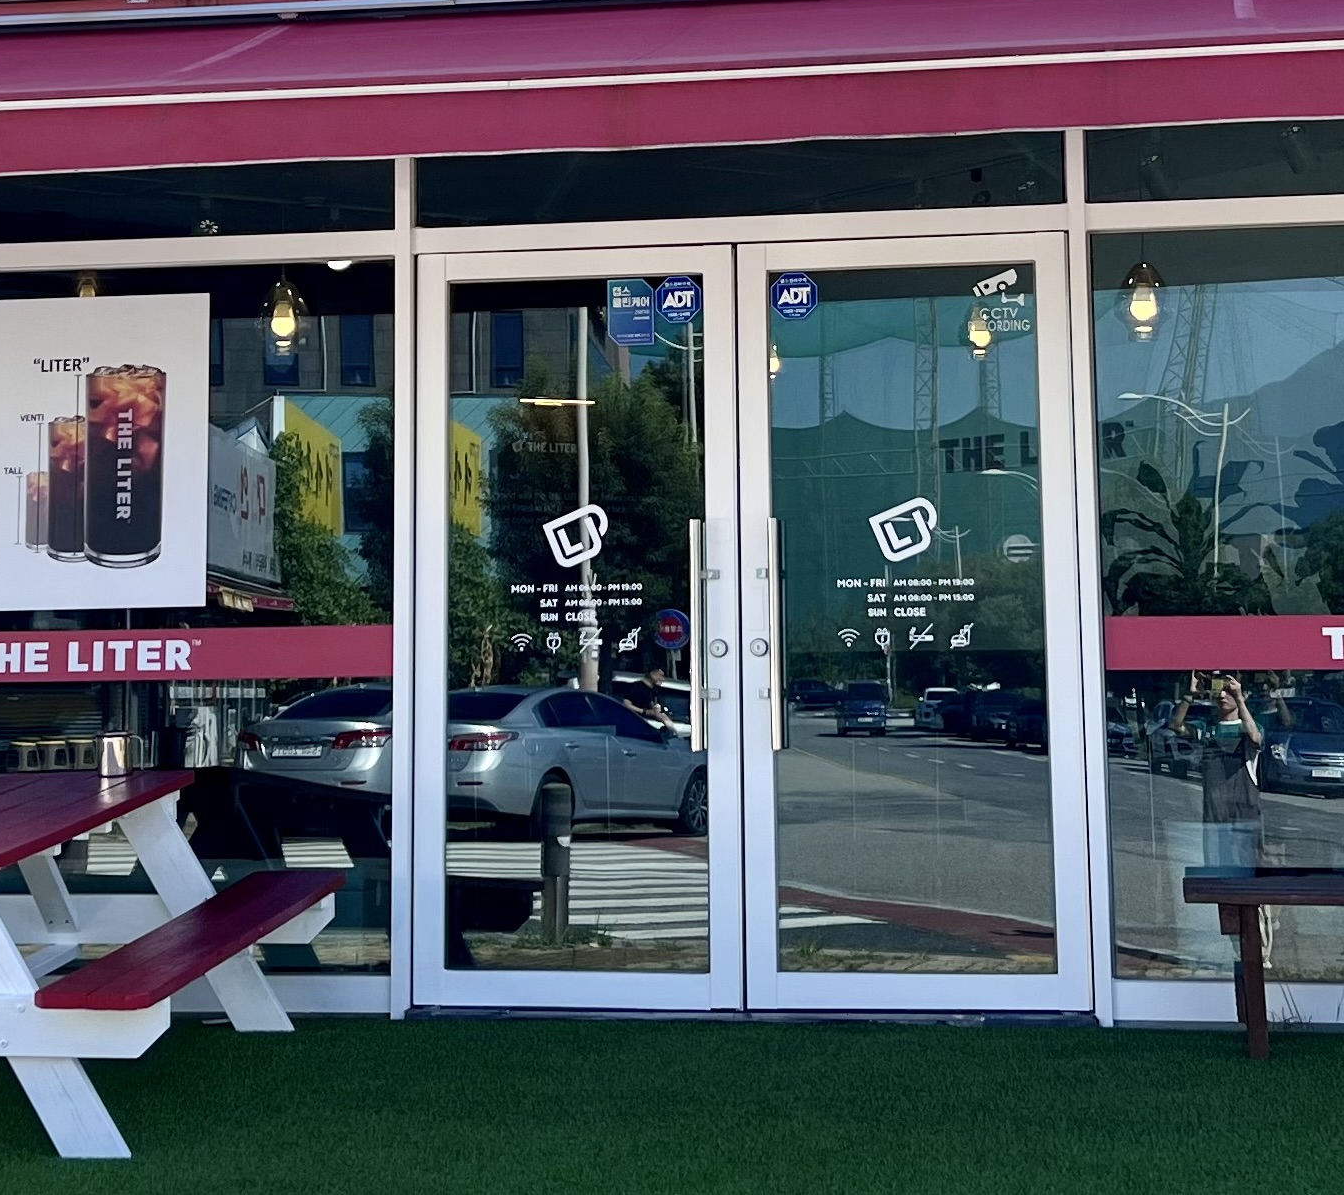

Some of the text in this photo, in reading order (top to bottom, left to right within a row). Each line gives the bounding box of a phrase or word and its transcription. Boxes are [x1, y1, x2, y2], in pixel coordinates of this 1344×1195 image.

[662, 290, 695, 310] ADT
[778, 287, 810, 305] ADT
[980, 307, 1018, 320] CCTV
[20, 414, 44, 422] VENTI
[116, 408, 133, 520] THE LITER
[4, 467, 23, 475] TALL
[511, 584, 535, 593] MON
[543, 584, 559, 593] FRI
[565, 584, 577, 592] AM
[608, 583, 620, 591] PM
[836, 579, 861, 588] MON
[870, 579, 886, 587] FRI
[938, 578, 951, 586] PM
[867, 594, 886, 602] SAT
[540, 599, 558, 608] SAT
[541, 612, 596, 622] SUN CLOSE
[868, 607, 926, 617] SUN CLOSE
[68, 639, 191, 672] LITER
